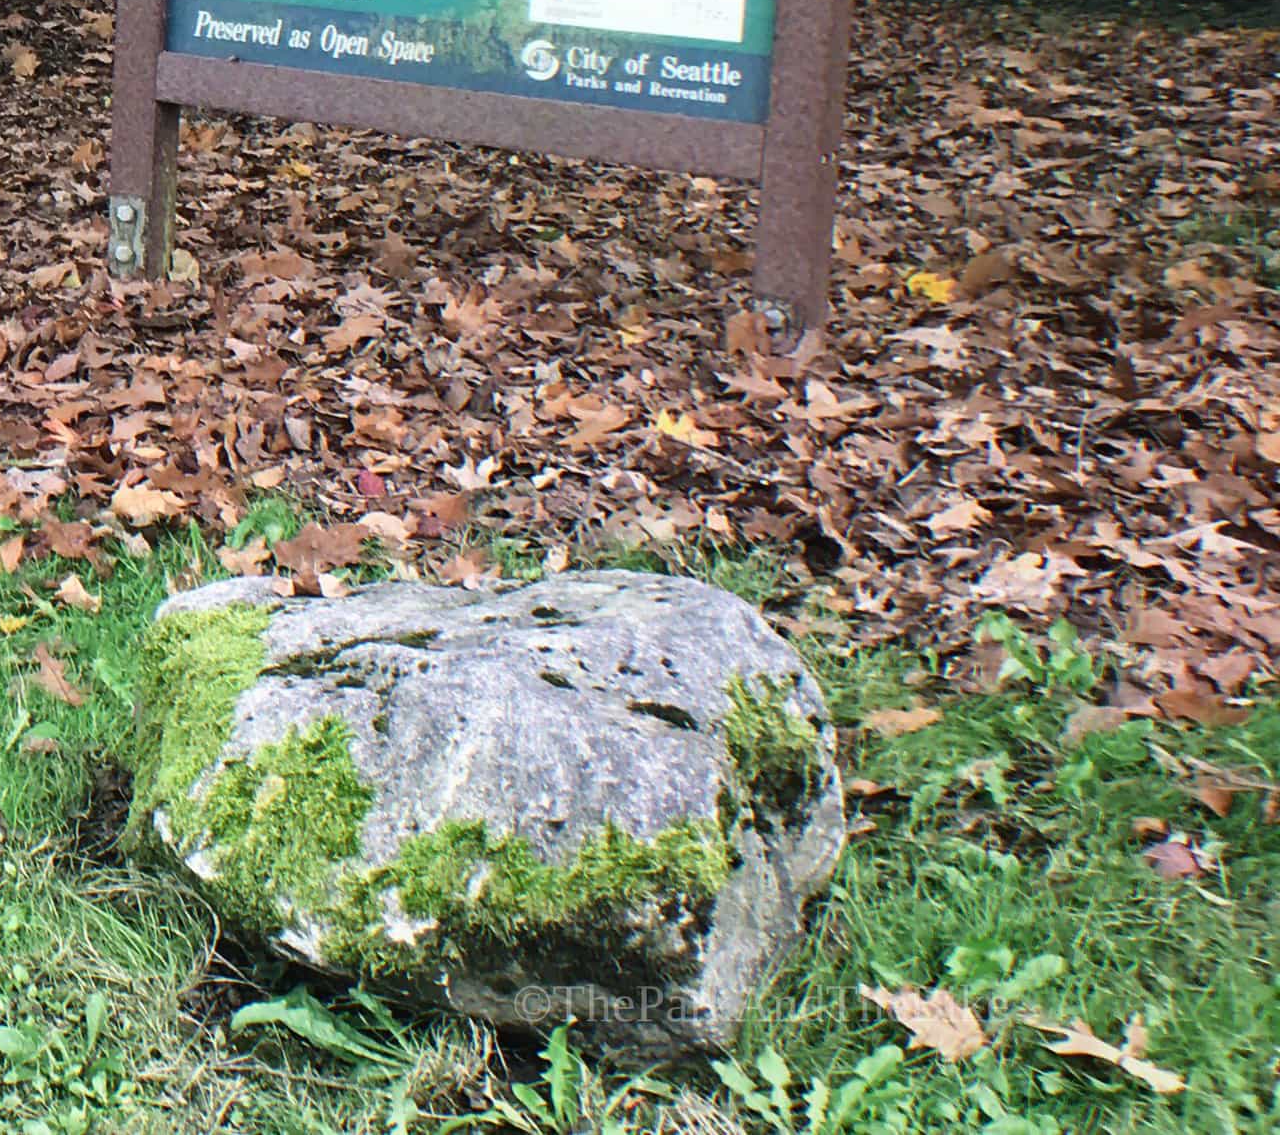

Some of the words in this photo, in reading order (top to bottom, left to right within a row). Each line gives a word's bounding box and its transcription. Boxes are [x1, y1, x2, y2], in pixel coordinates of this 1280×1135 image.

[194, 10, 283, 46] Preserved
[289, 29, 311, 49] as
[320, 24, 369, 59] Open
[379, 30, 435, 65] Space
[566, 46, 613, 75] City
[625, 53, 650, 76] of
[661, 55, 743, 86] Seattle
[566, 73, 608, 90] Parks
[615, 80, 641, 94] and
[649, 82, 727, 104] Recreation
